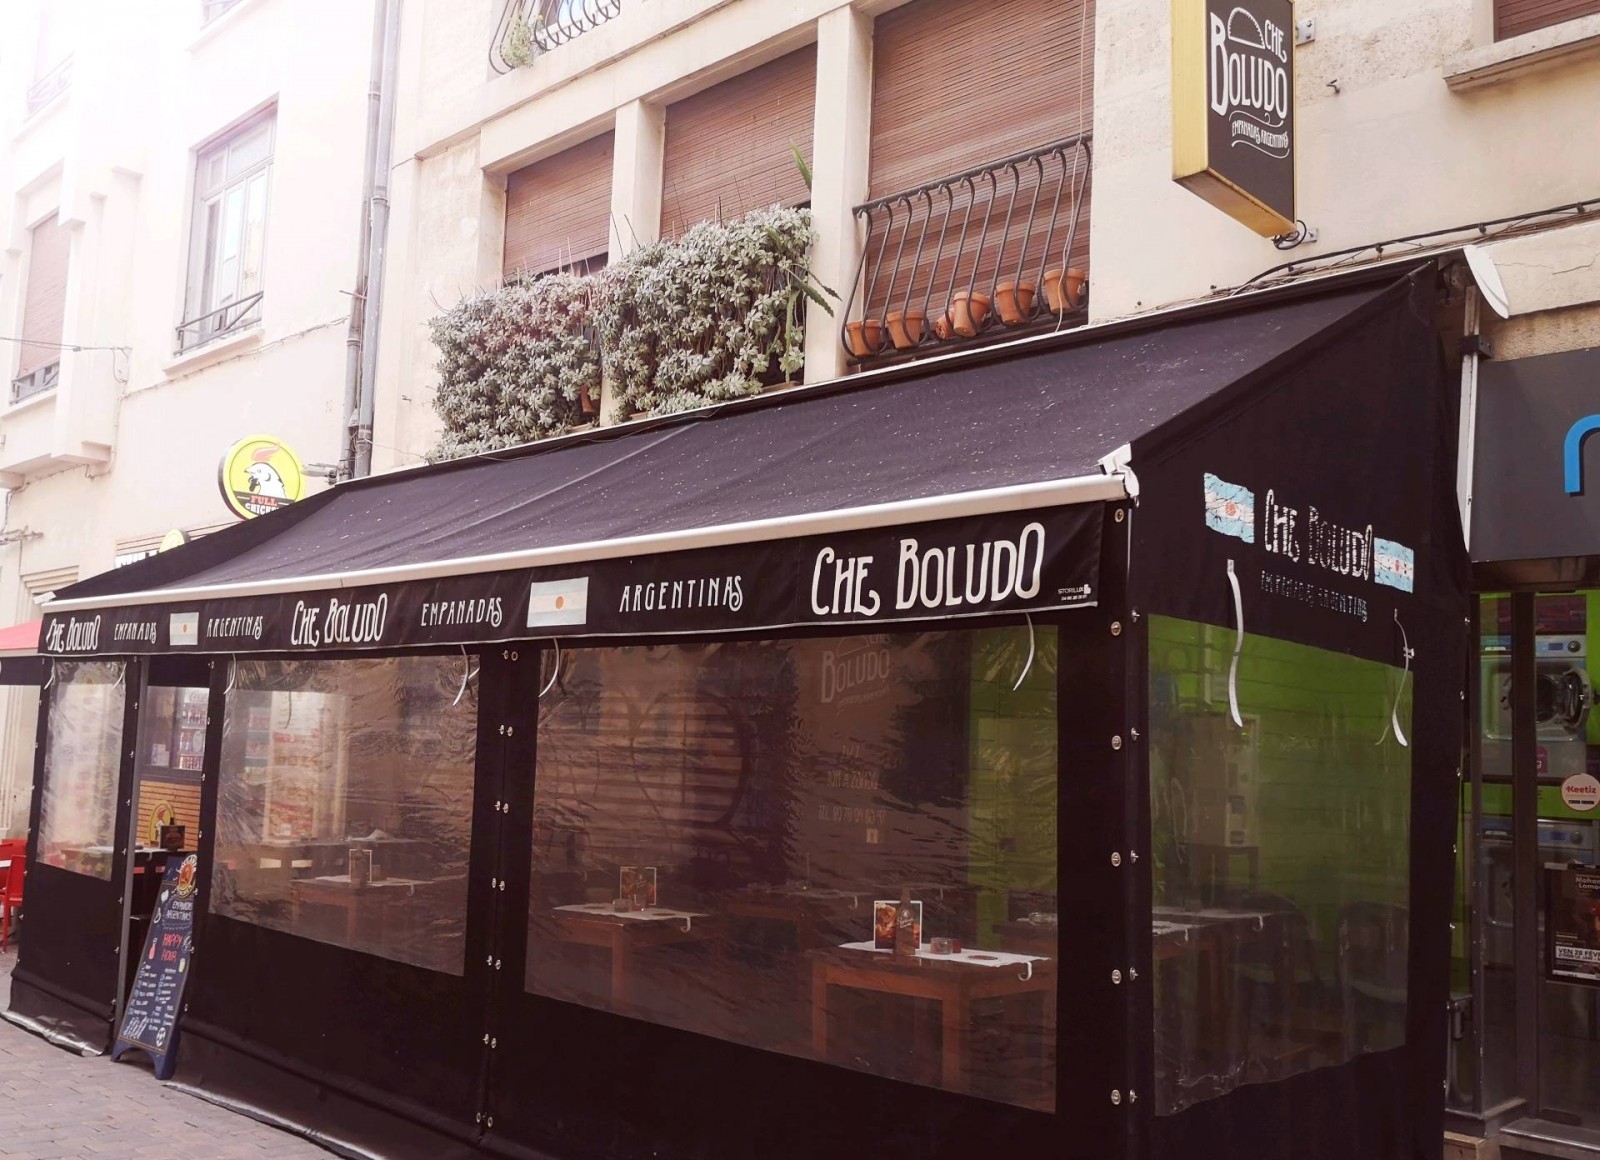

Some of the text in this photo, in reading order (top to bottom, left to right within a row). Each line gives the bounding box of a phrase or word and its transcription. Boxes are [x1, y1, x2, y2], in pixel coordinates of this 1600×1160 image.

[1264, 19, 1288, 63] CHE
[1210, 12, 1288, 119] BOLUDO
[1231, 119, 1260, 145] EMPANADAS
[244, 502, 280, 515] CHICK
[250, 495, 278, 507] FULL
[1264, 488, 1373, 581] CHE BOLUDO
[811, 522, 1046, 616] CHE BOLUDO
[619, 575, 743, 612] ARGENTINAS
[290, 592, 388, 647] CHE BOLUDO
[420, 597, 503, 627] EMPANADAS
[46, 615, 101, 653] CHE BOLUDO
[114, 622, 157, 644] EMPANADAS
[206, 616, 263, 640] ARGENTINAS
[820, 648, 890, 703] BOLUDO
[1566, 785, 1597, 794] Keetiz
[160, 948, 178, 962] HOUR
[162, 932, 183, 949] HAPPY
